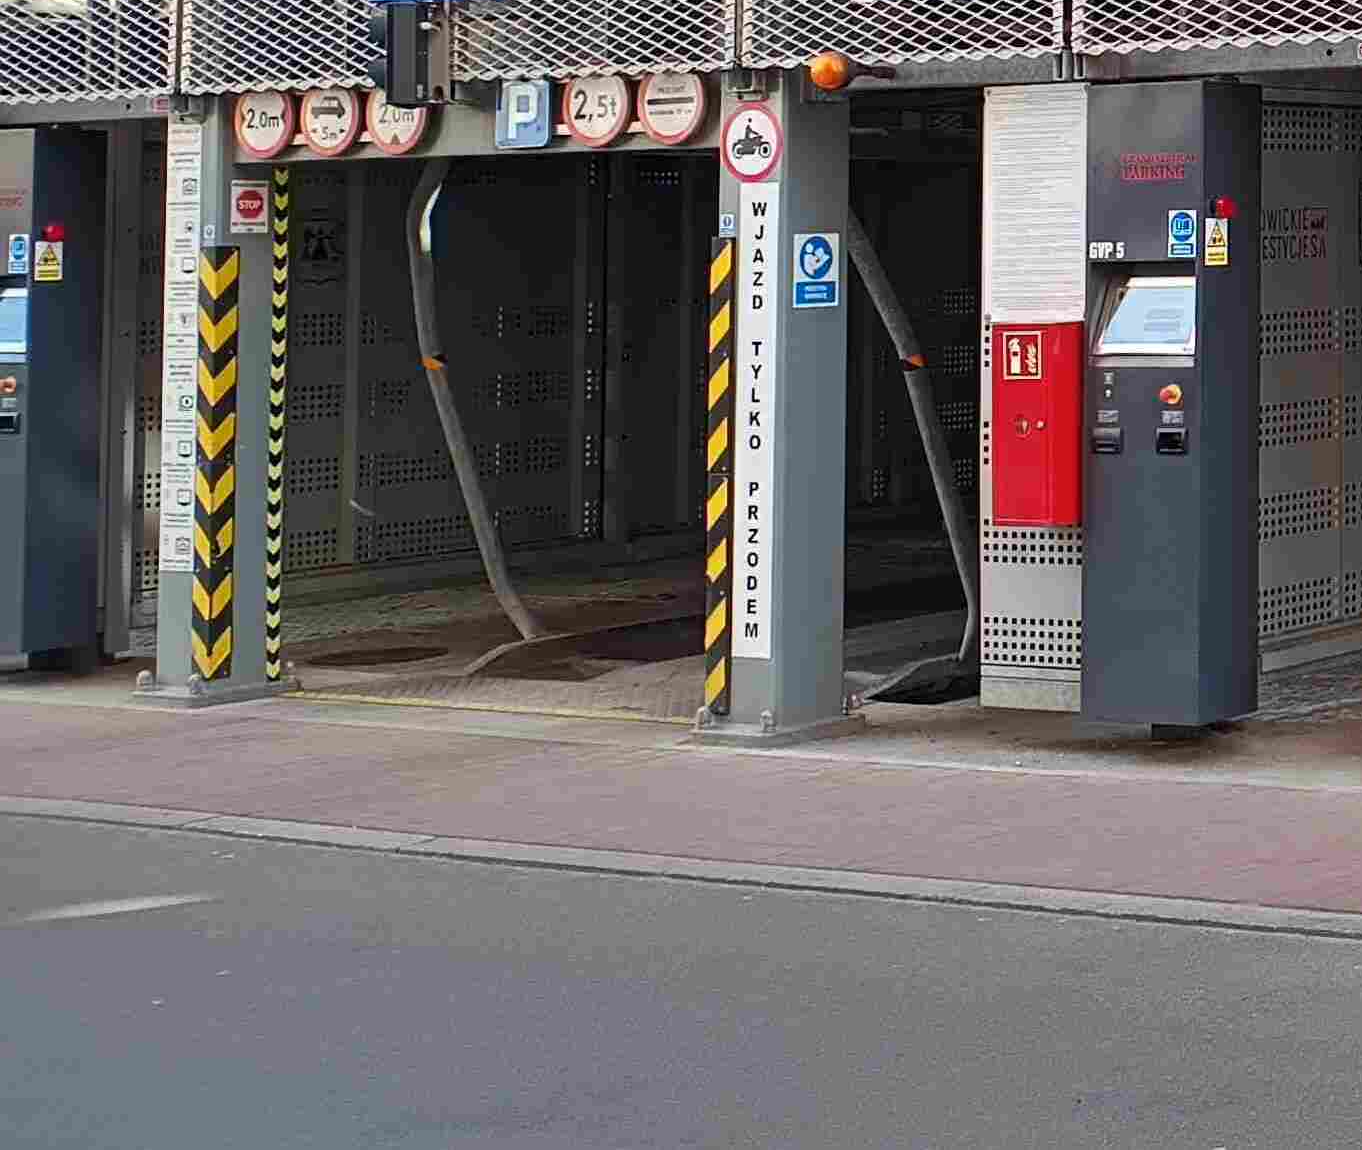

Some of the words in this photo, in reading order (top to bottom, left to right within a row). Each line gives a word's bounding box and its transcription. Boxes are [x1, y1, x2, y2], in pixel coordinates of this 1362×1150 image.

[507, 83, 539, 140] P
[238, 199, 262, 211] STOP
[752, 202, 767, 310] WJAZD
[1089, 242, 1113, 259] GVP
[1114, 241, 1125, 259] 5
[749, 341, 762, 450] TYLKO
[744, 481, 760, 638] PRZODEM
